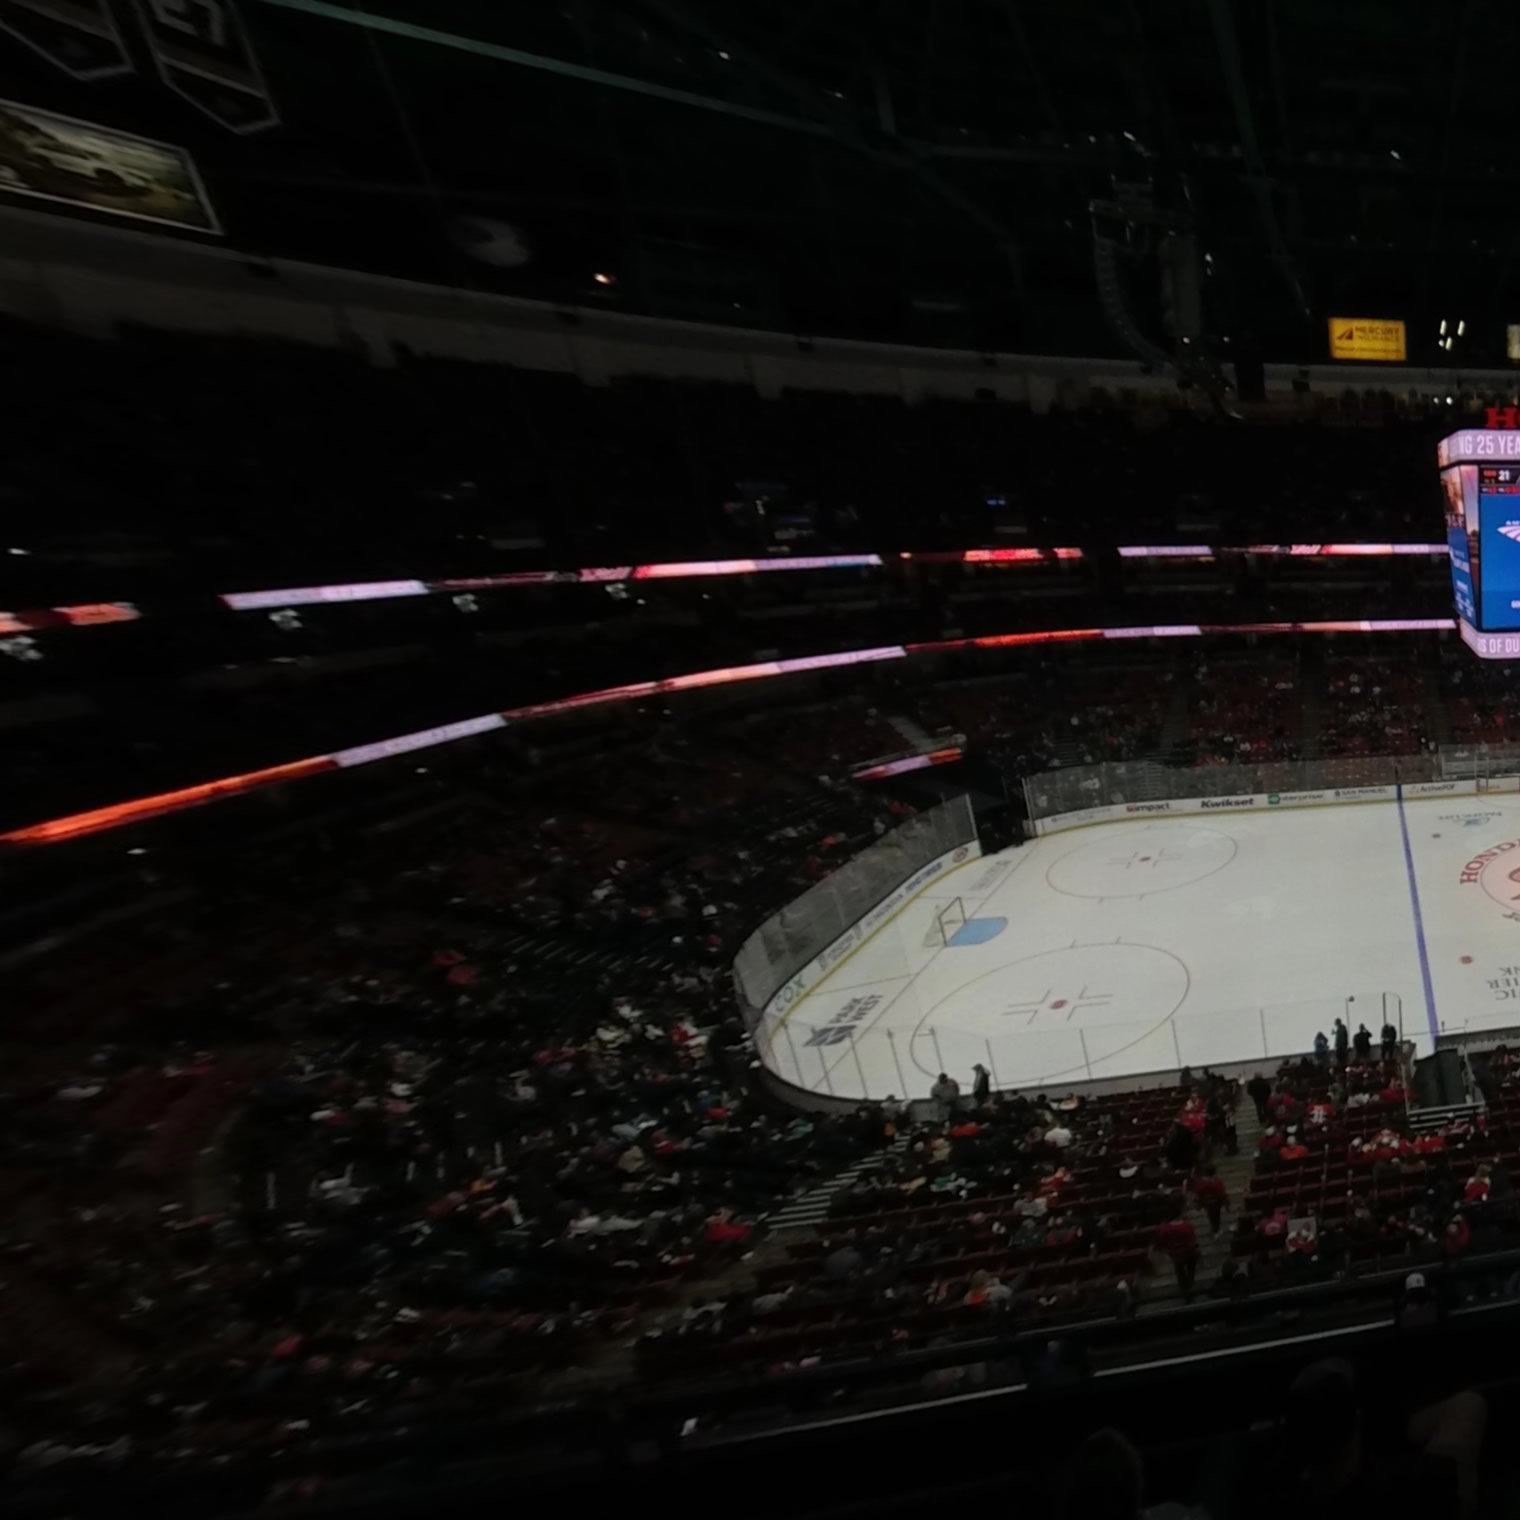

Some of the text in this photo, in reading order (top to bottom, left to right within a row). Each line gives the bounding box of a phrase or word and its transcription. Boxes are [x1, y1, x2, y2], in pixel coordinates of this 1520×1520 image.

[1476, 435, 1495, 455] 25
[1489, 638, 1502, 653] OF
[1201, 797, 1255, 808] Kwikset
